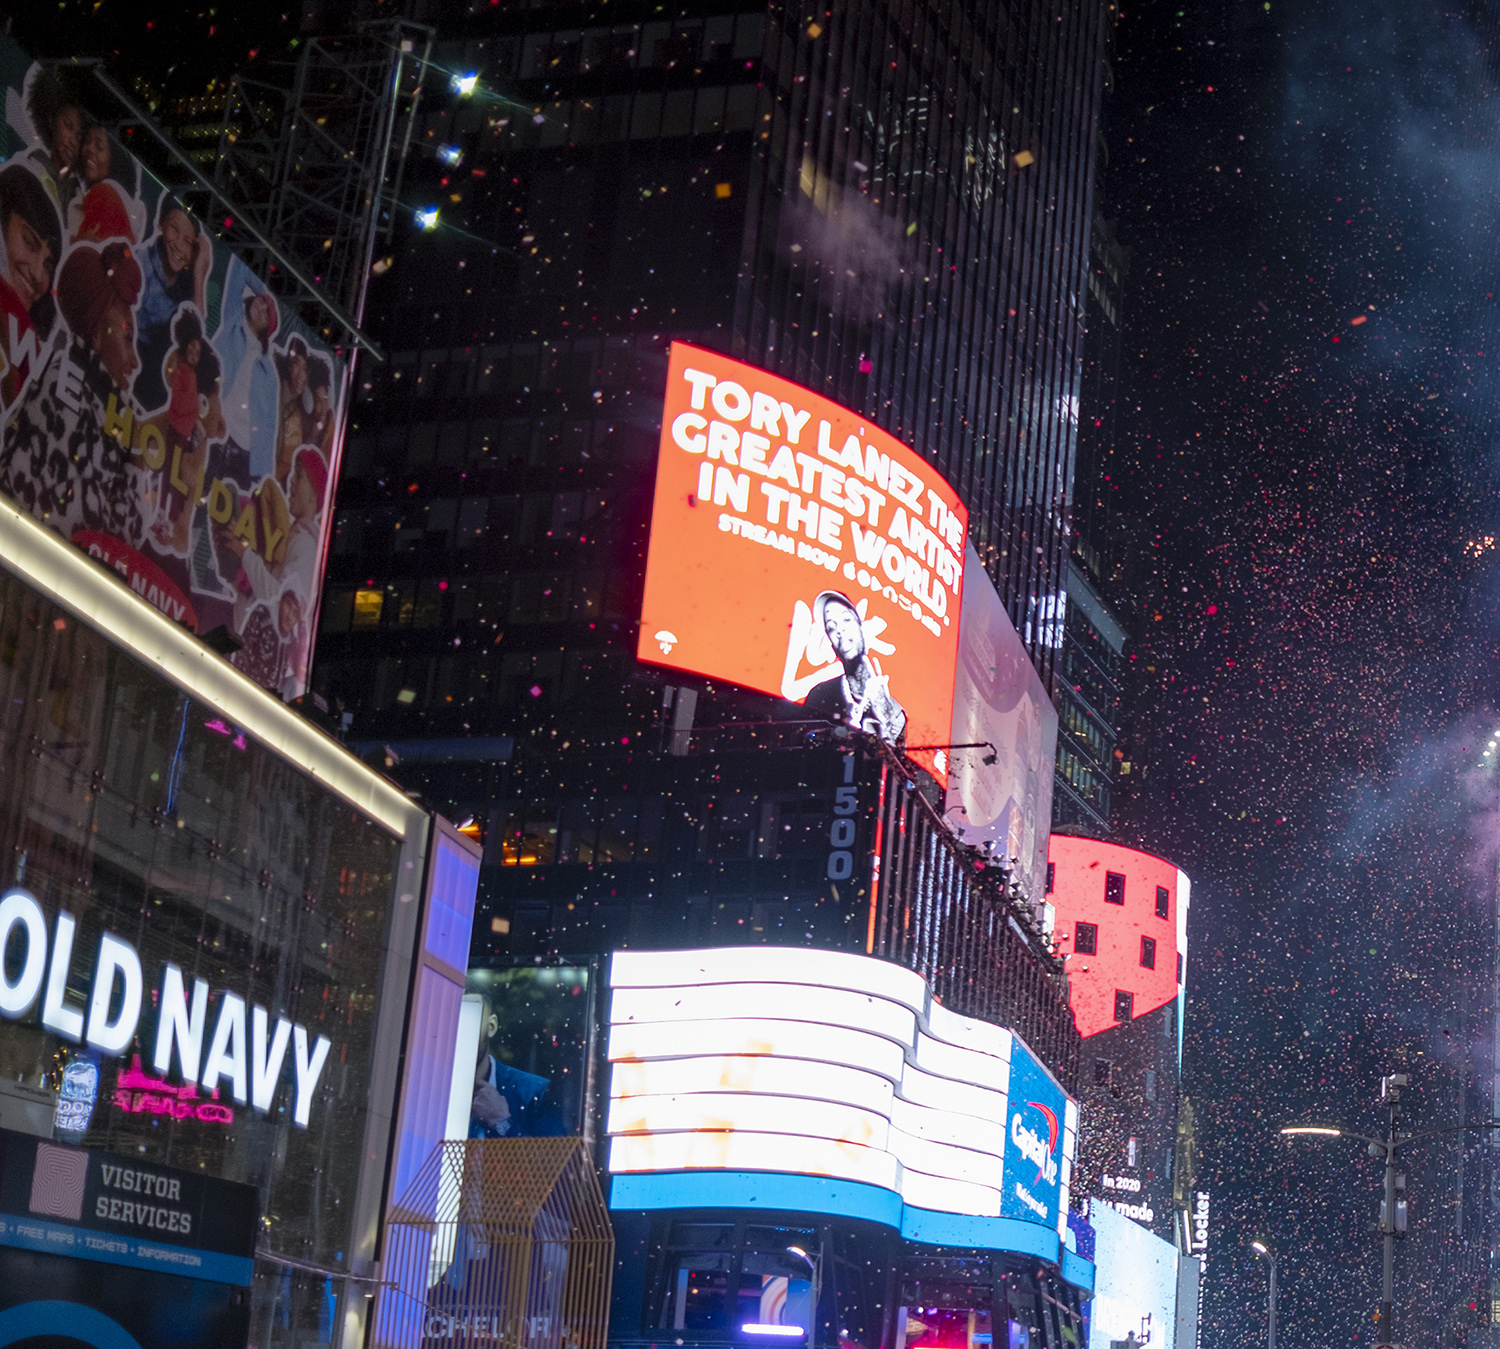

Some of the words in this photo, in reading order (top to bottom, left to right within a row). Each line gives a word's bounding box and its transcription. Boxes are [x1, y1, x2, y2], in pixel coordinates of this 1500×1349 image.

[8, 313, 85, 413] WE
[104, 392, 283, 562] HOLIDAY
[672, 412, 886, 525] GREATEST
[889, 507, 962, 595] ARTIST
[684, 368, 811, 443] TORY
[818, 420, 925, 516] LANEZ
[926, 488, 963, 557] THE
[698, 462, 750, 513] IN
[760, 482, 844, 551] THE
[852, 521, 950, 627] WORLD.
[718, 513, 796, 554] STREAM
[798, 542, 841, 572] NOW
[131, 572, 185, 622] NAVY
[0, 889, 143, 1055] OLD
[154, 963, 331, 1128] NAVY
[96, 1196, 192, 1234] SERVICES
[101, 1163, 181, 1200] VISITOR
[17, 1225, 44, 1240] FREE
[47, 1230, 74, 1244] MAPS
[85, 1237, 128, 1253] TICKETS
[137, 1246, 201, 1266] INFORMATION
